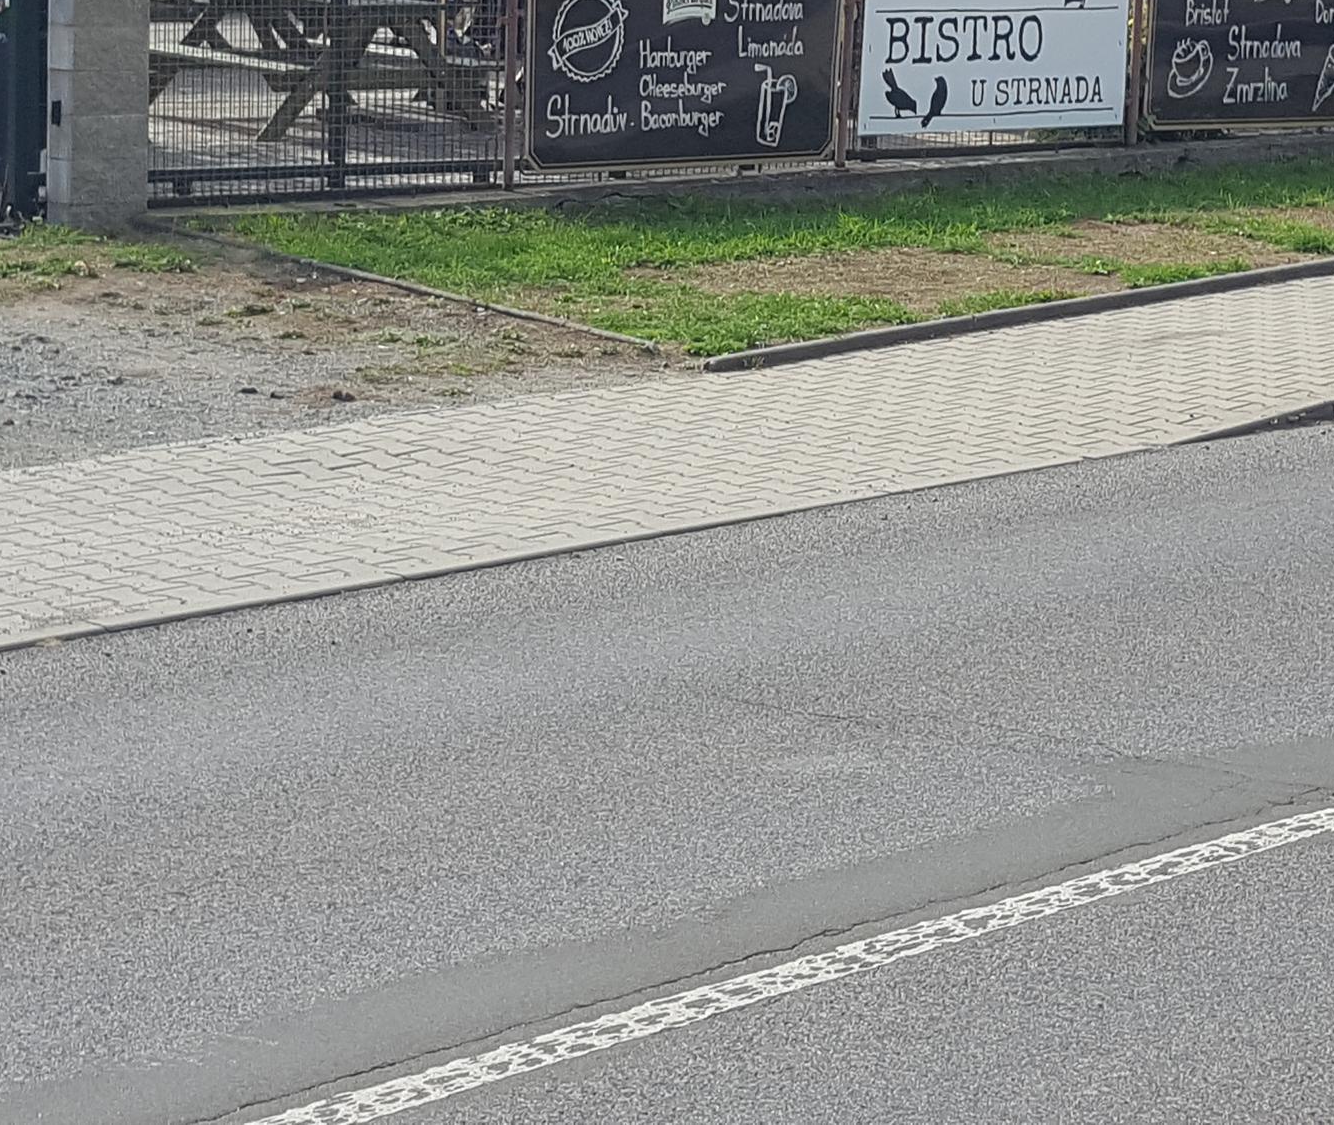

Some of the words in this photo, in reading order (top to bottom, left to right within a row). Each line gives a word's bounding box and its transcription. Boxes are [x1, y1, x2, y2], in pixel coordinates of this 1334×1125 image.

[639, 35, 712, 75] Hamburger
[884, 15, 1043, 65] BISTRO
[1227, 23, 1301, 61] Strnadova
[971, 79, 987, 107] U
[994, 75, 1104, 107] STRNADA
[641, 98, 725, 138] Baconburger
